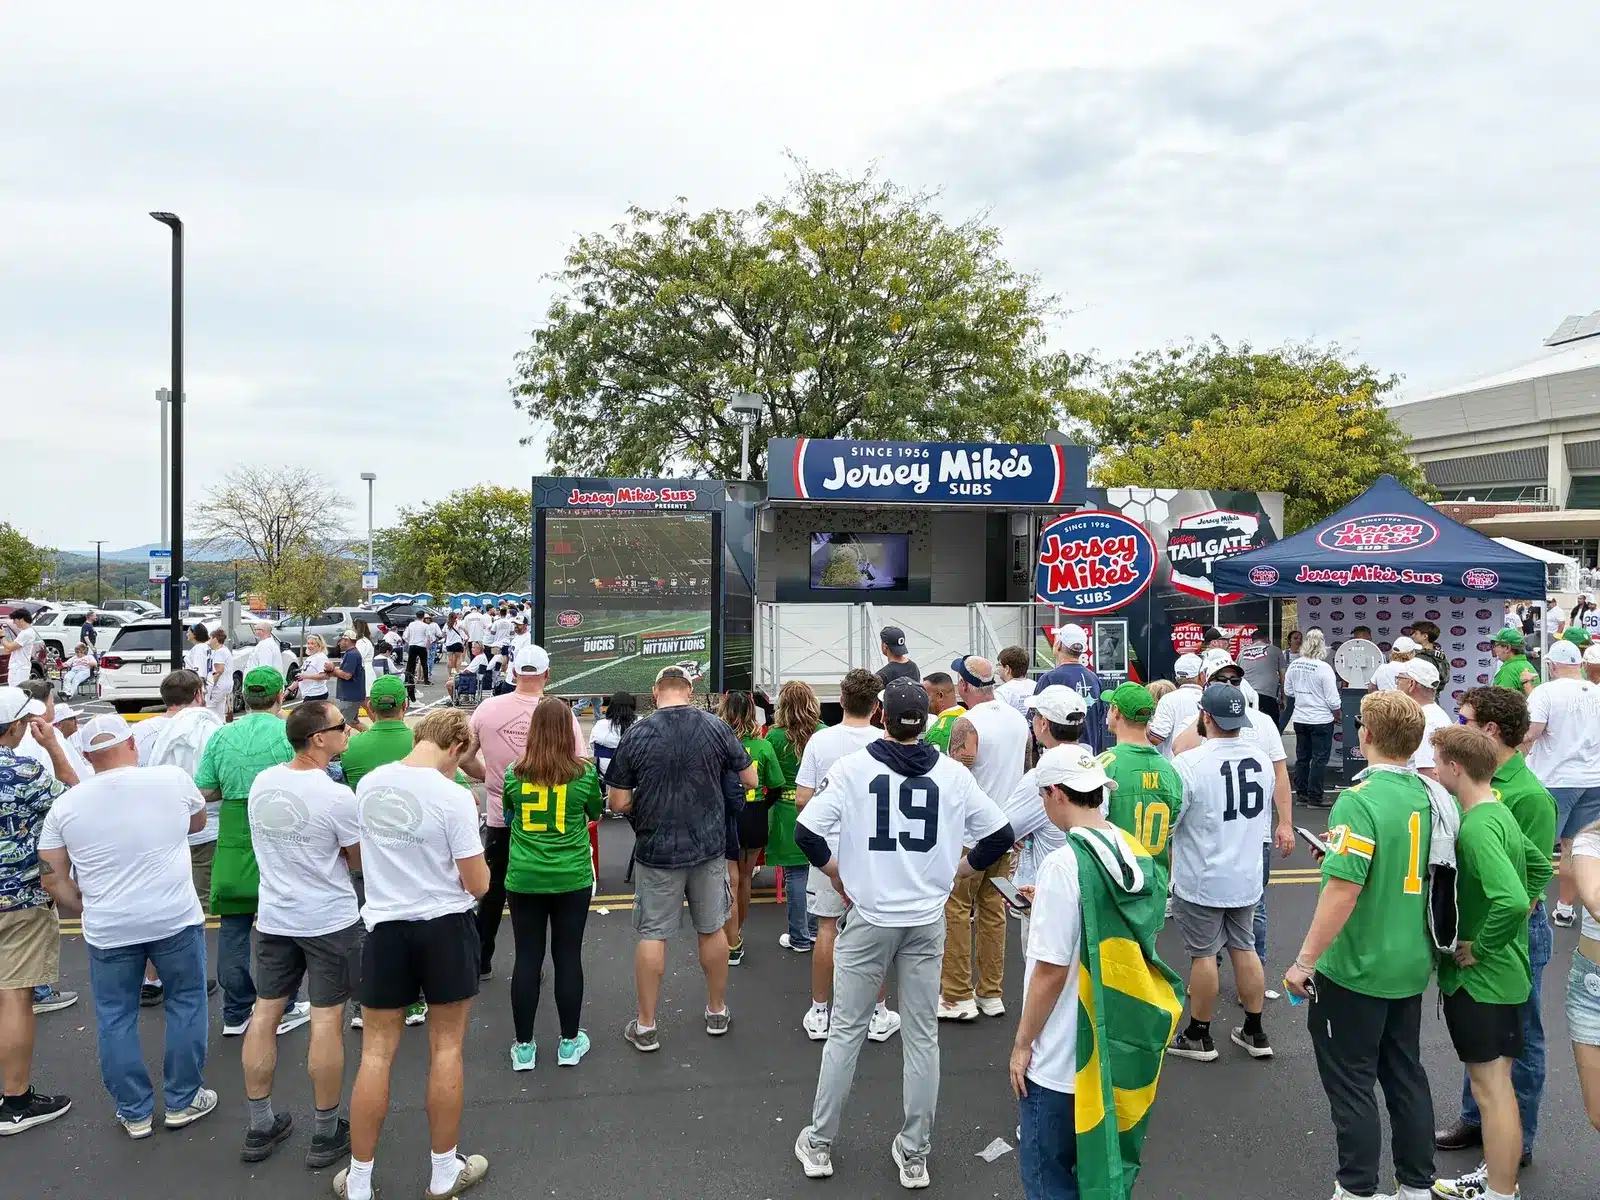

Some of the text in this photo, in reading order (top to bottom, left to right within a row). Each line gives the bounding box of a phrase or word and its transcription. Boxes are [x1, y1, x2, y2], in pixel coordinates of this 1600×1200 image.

[851, 446, 930, 458] SINCE 1956
[823, 447, 1033, 494] Jersey Mike's
[568, 488, 615, 507] Jersey
[616, 487, 659, 503] Mike's
[949, 482, 993, 496] SUBS
[1064, 521, 1111, 533] SINCE 1956
[1334, 523, 1423, 537] Jersey
[1040, 534, 1138, 565] Jersey
[1167, 533, 1252, 562] TAILGATE
[1048, 559, 1139, 594] Mike's
[1296, 565, 1349, 586] Jersey
[1350, 564, 1401, 582] Mike's
[1075, 591, 1112, 605] SUBS
[1585, 615, 1598, 627] 26
[583, 638, 615, 653] DUCKS
[623, 639, 636, 652] VS
[1171, 632, 1205, 641] SOCIAL
[642, 638, 706, 655] NITTANY LIONS
[1142, 772, 1159, 789] NIX
[1219, 757, 1264, 822] 16
[521, 782, 568, 835] 21
[868, 773, 940, 853] 19
[1134, 801, 1171, 856] 10
[1403, 811, 1422, 895] 1
